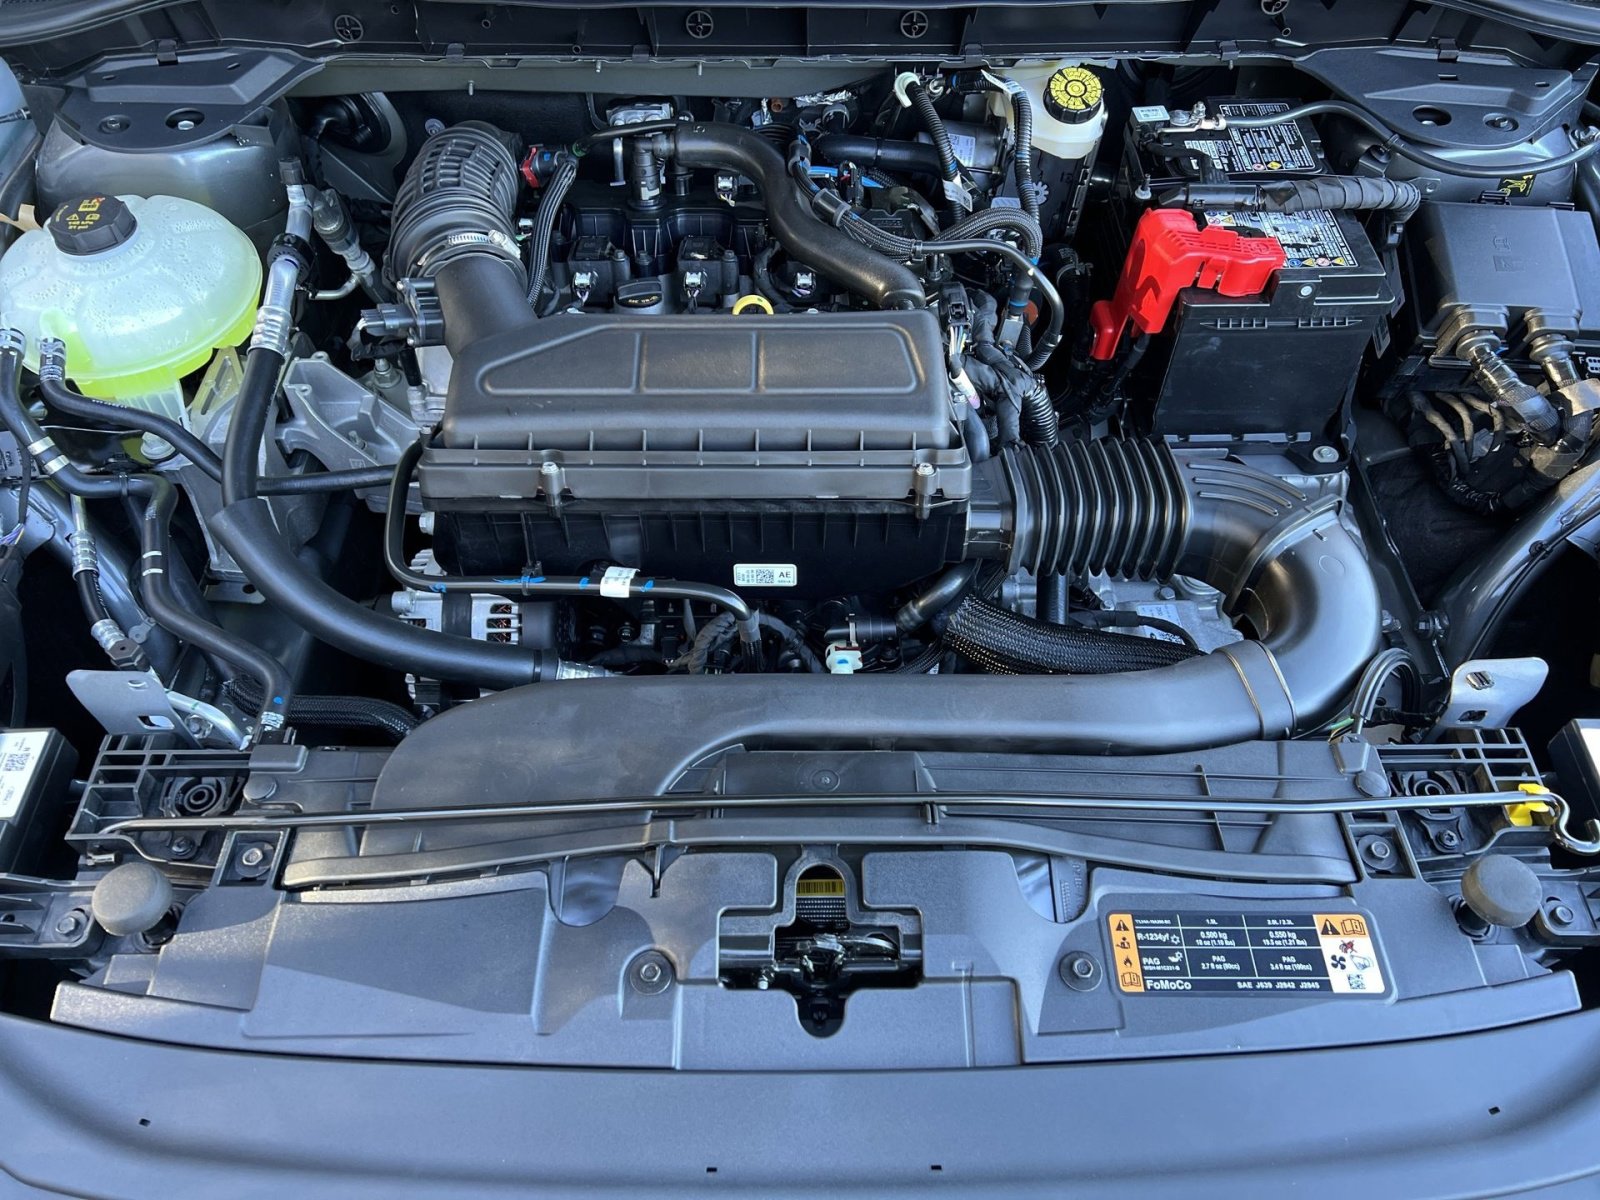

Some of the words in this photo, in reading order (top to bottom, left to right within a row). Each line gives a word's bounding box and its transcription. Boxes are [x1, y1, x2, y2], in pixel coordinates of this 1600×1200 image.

[1136, 932, 1170, 942] R-1234yf
[1200, 931, 1218, 939] 0.500
[1218, 931, 1228, 940] kg
[1268, 930, 1287, 939] 0.550
[1286, 930, 1297, 940] kg
[1142, 957, 1160, 965] PAG
[1146, 979, 1192, 990] FoMoCo
[1236, 981, 1253, 989] SAE
[1255, 981, 1273, 989] J639
[1275, 981, 1296, 989] J2842
[1299, 981, 1320, 989] J2845
